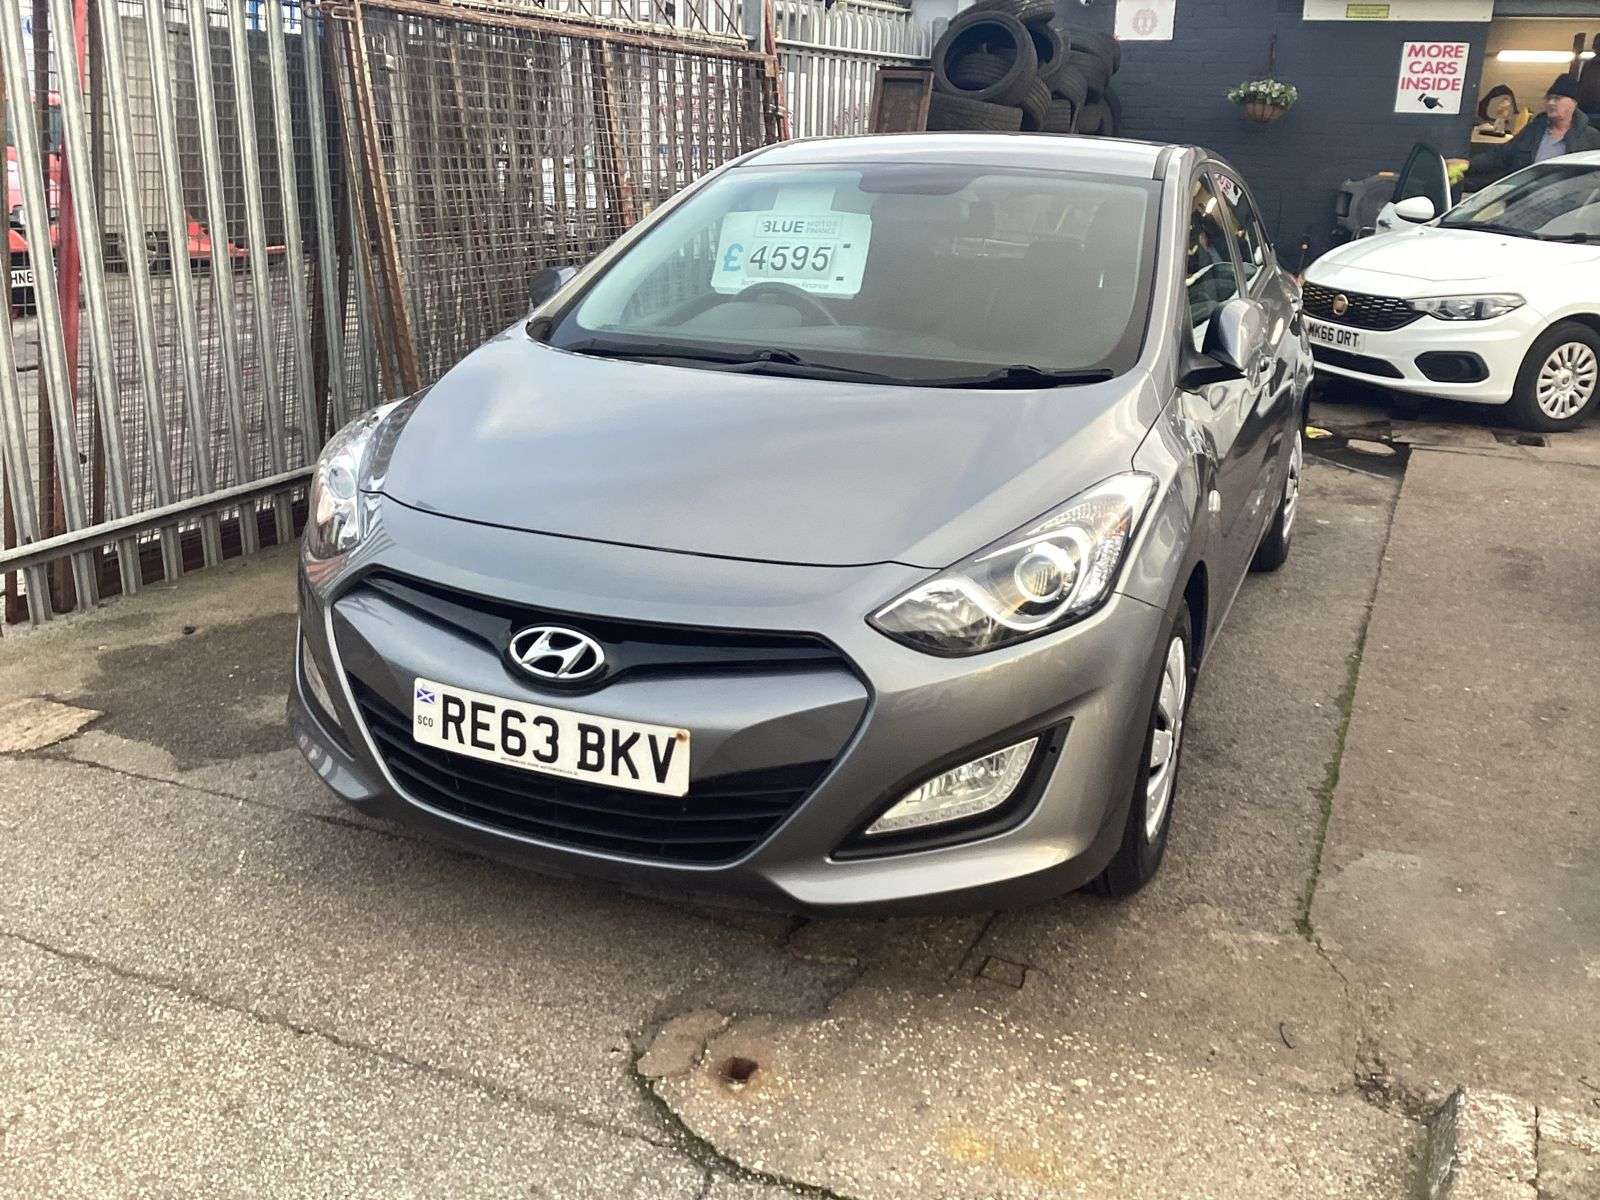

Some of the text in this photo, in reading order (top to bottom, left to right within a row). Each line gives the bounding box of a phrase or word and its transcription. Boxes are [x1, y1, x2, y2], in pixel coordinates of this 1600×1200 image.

[1408, 44, 1464, 58] MORE
[1408, 61, 1458, 75] CARS
[1400, 77, 1461, 91] INSIDE
[750, 245, 832, 272] 4595
[1337, 329, 1360, 347] ORT
[417, 715, 434, 728] SCO
[441, 693, 678, 784] RE63 BKV
